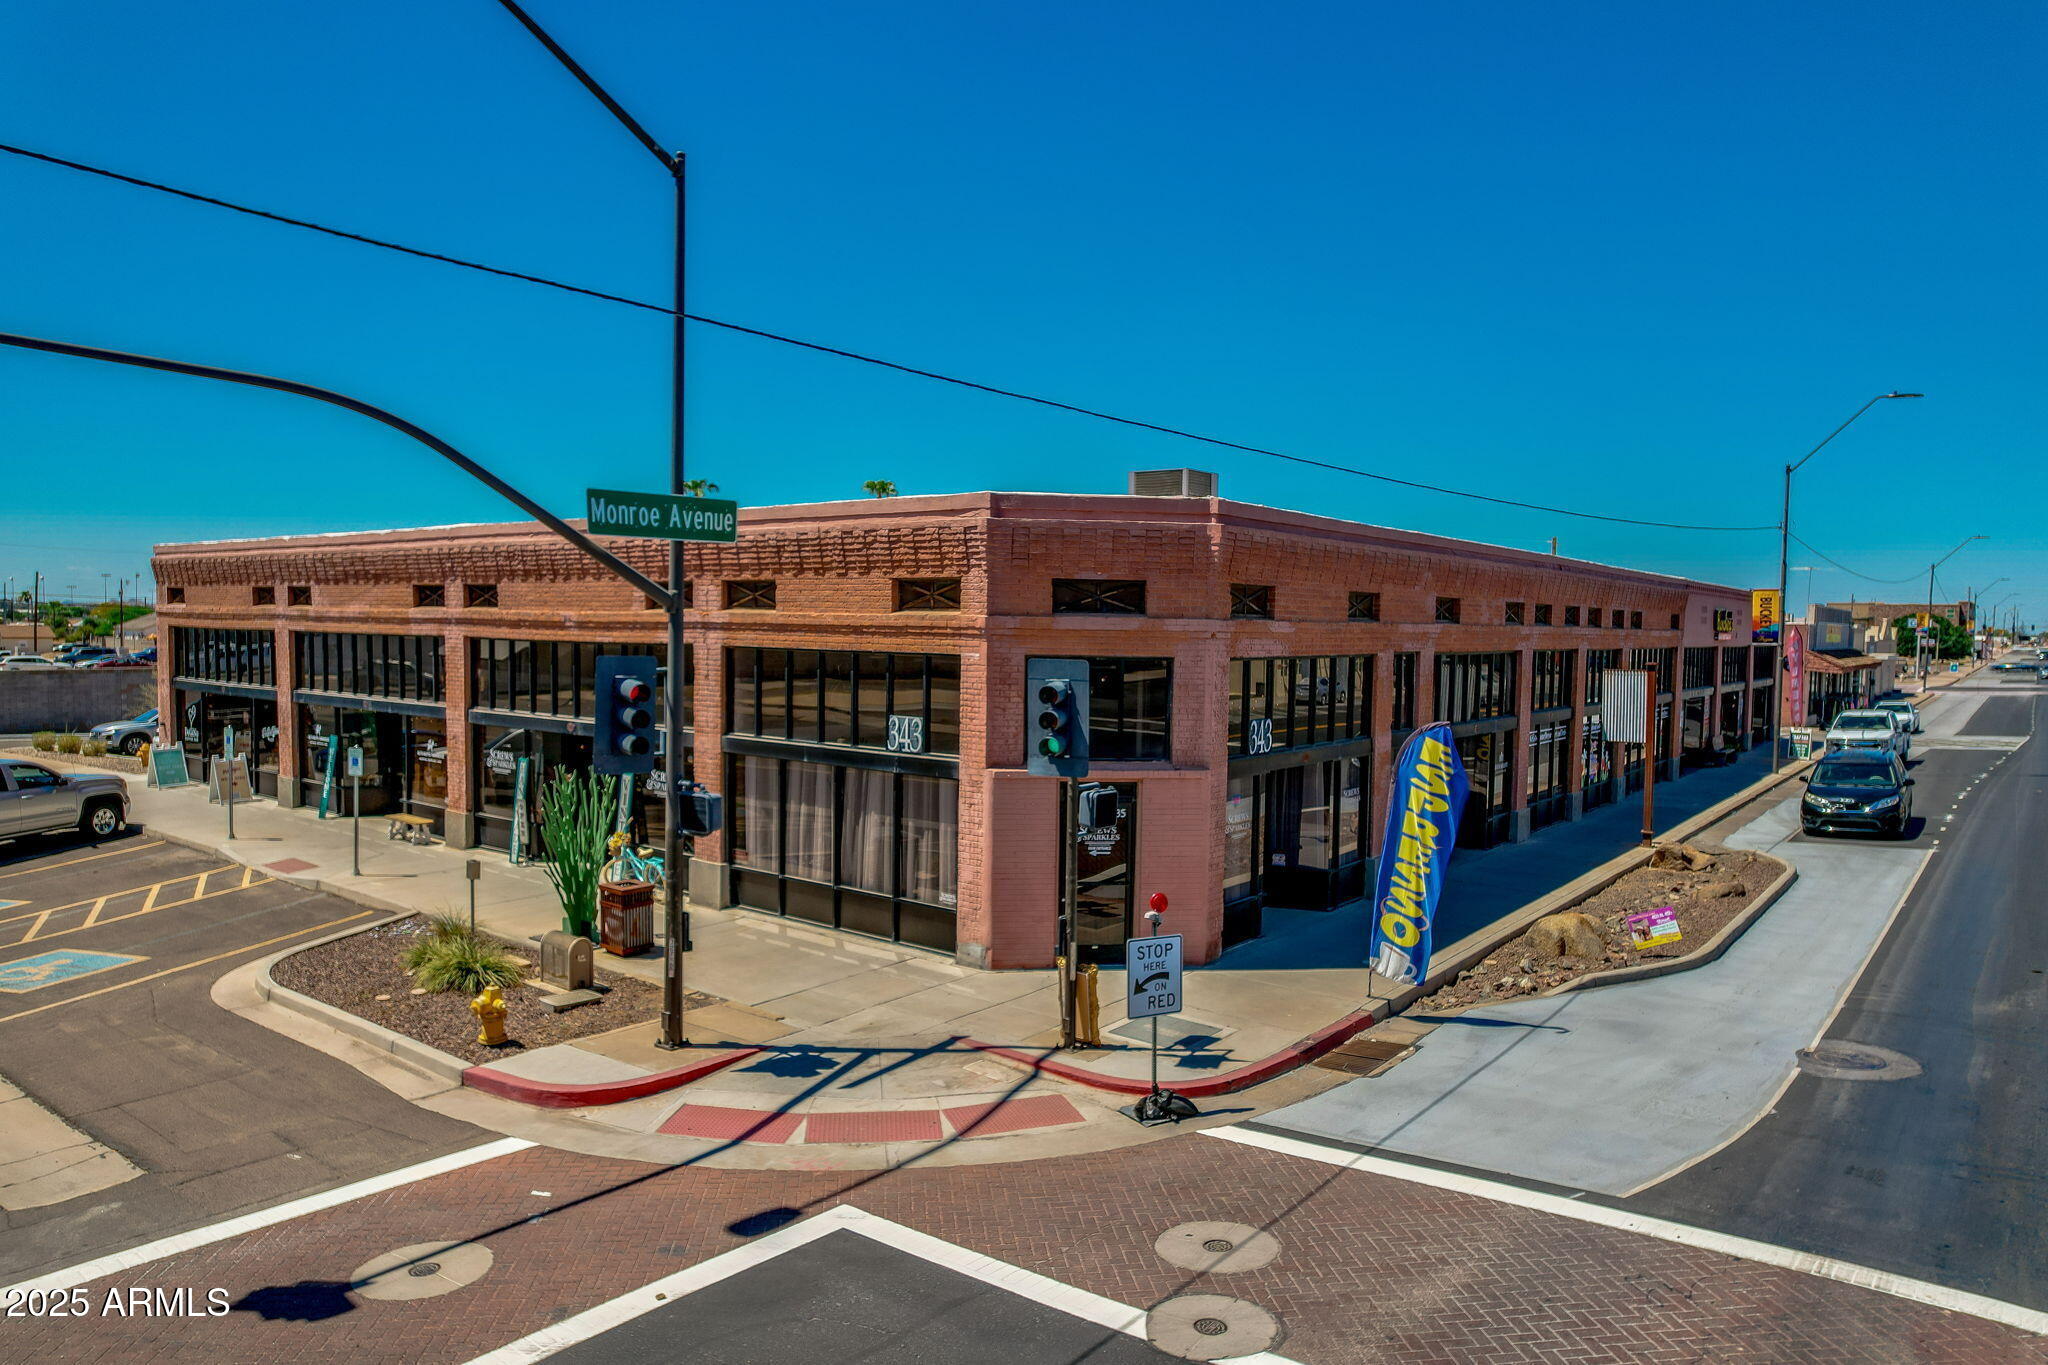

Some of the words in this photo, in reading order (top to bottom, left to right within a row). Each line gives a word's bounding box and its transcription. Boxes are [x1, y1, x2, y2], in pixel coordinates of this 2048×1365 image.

[590, 497, 660, 527] Monroe
[669, 504, 733, 531] Avenue
[887, 715, 923, 752] 343
[1249, 718, 1272, 755] 343
[1136, 943, 1173, 960] STOP
[1143, 961, 1167, 972] HERE
[1154, 981, 1167, 992] ON
[1147, 993, 1176, 1010] RED
